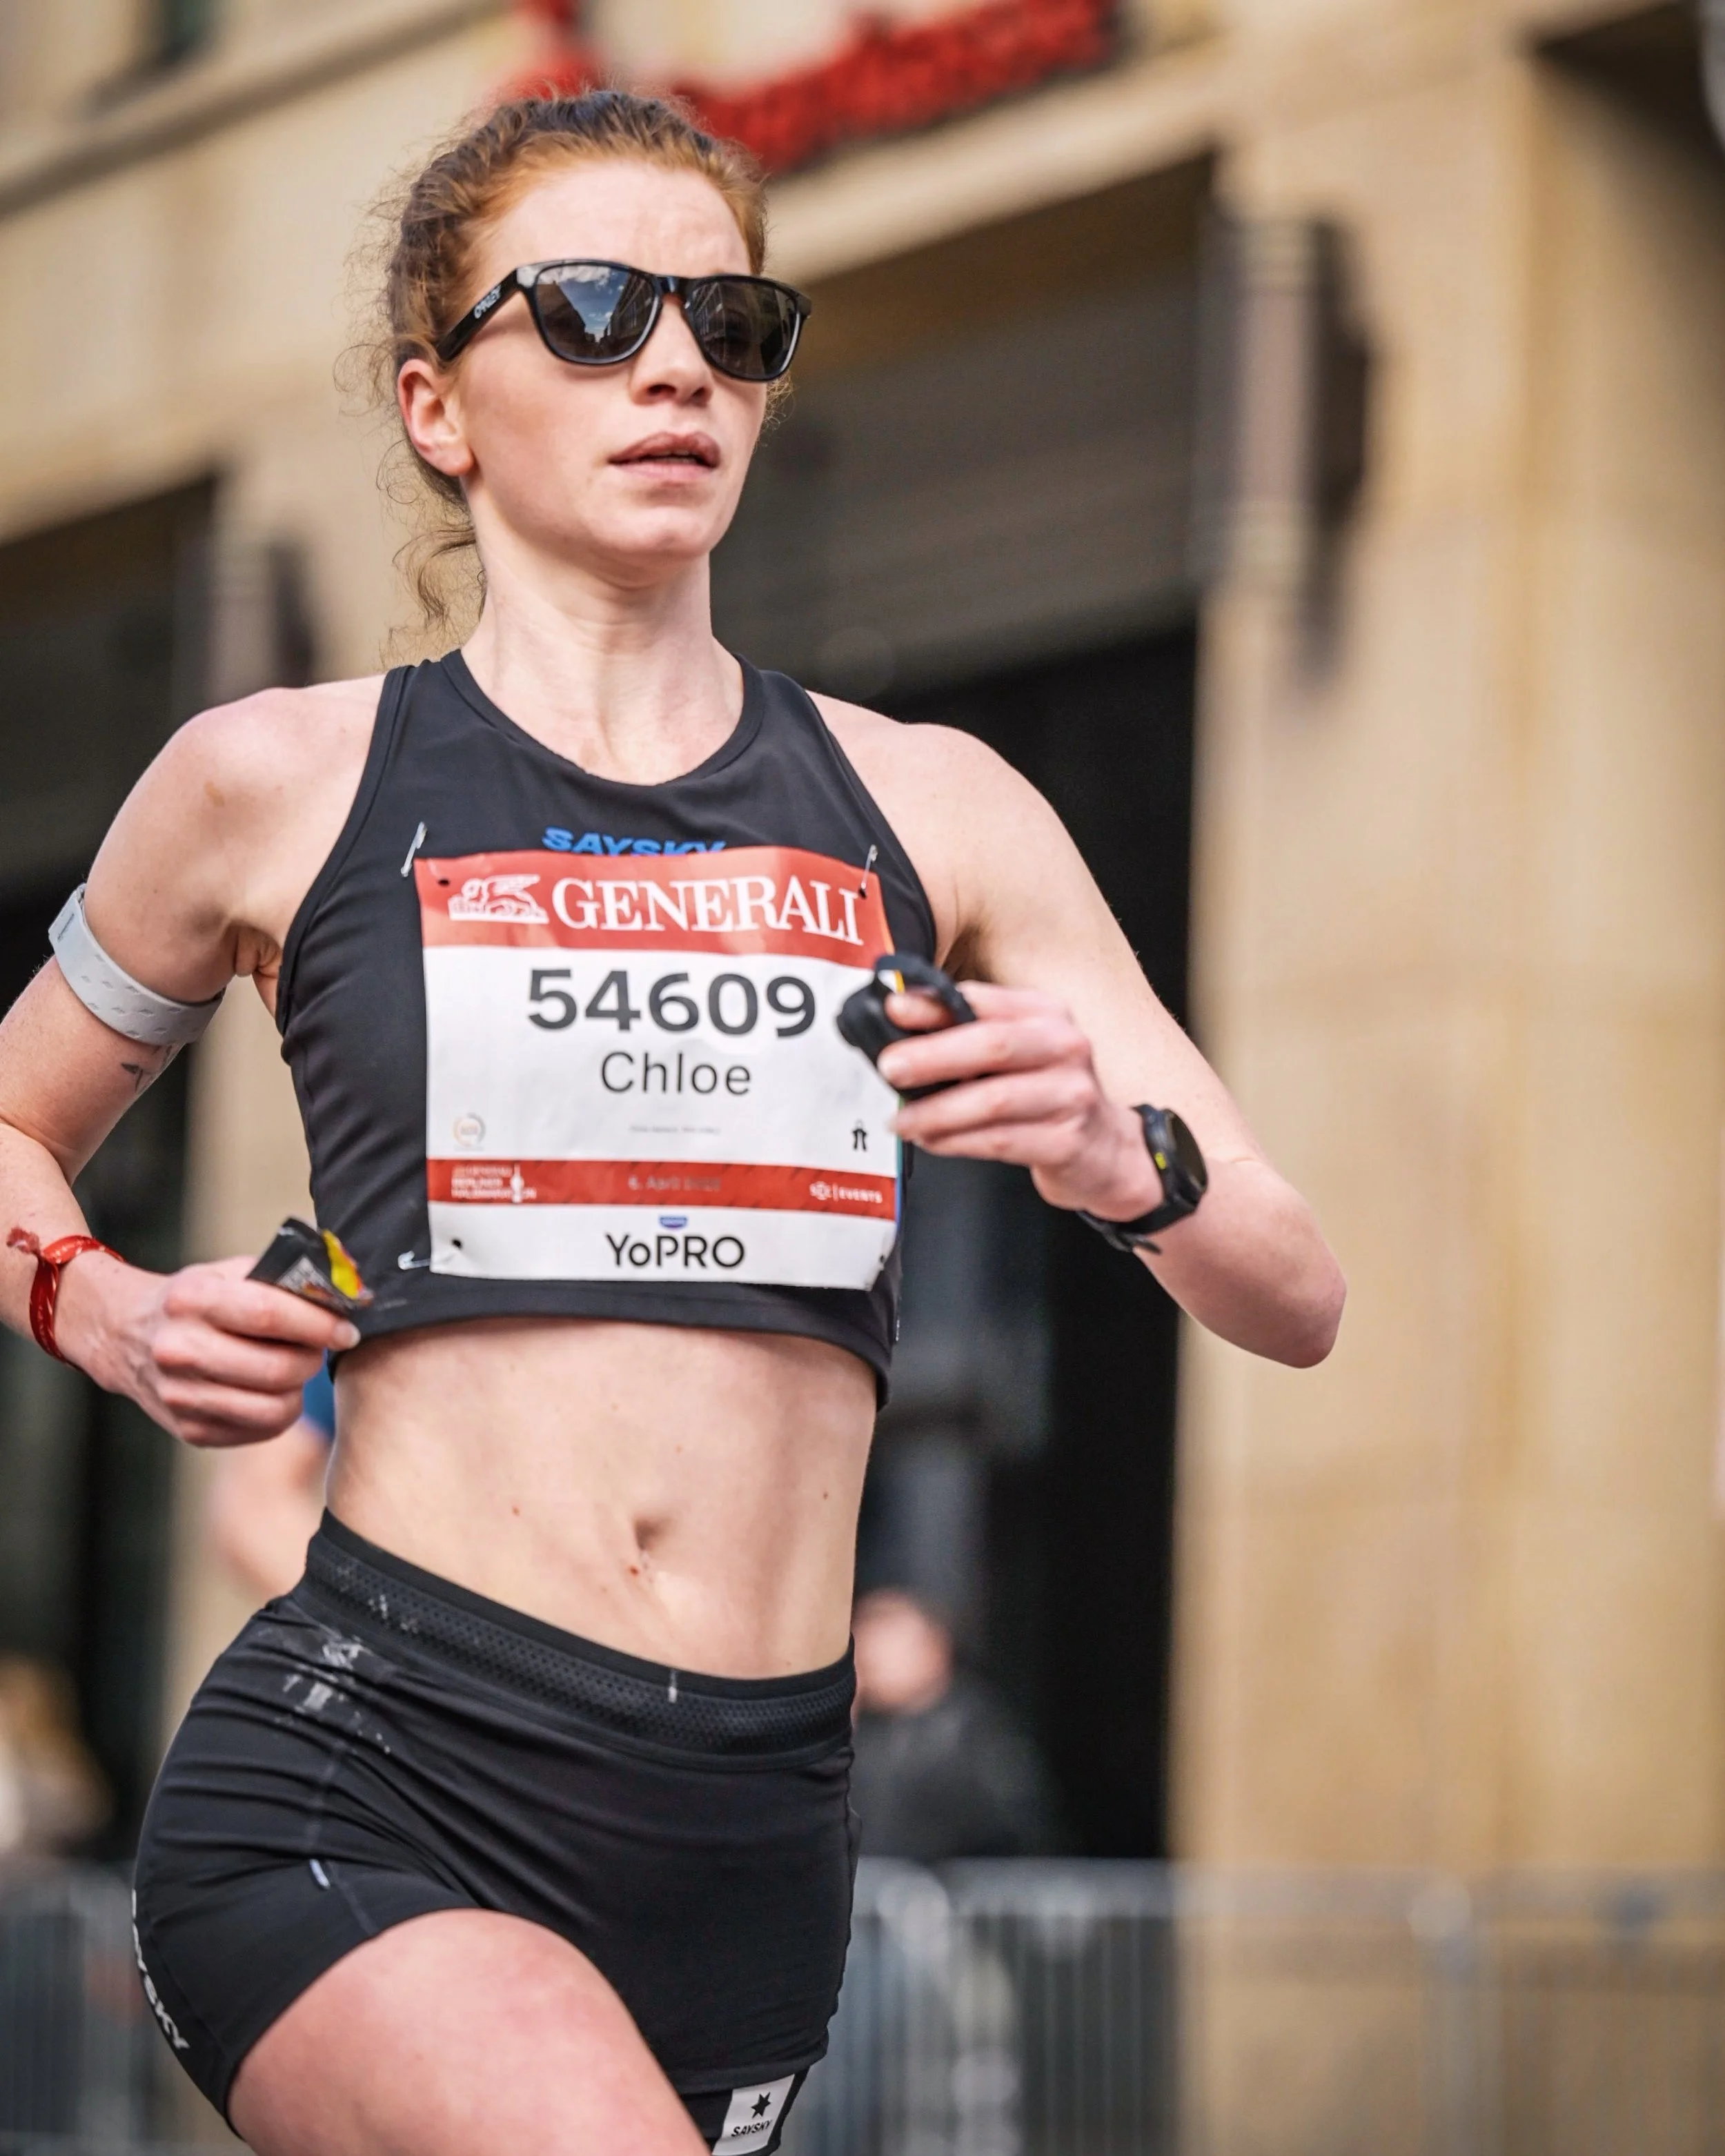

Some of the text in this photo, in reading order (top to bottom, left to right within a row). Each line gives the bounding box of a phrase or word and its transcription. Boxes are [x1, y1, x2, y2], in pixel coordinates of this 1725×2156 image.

[551, 876, 864, 946] GENERALI
[529, 968, 816, 1038] 54609
[602, 1051, 751, 1096] Chloe
[605, 1234, 745, 1268] YoPRO
[731, 2119, 773, 2137] SAYSKY
